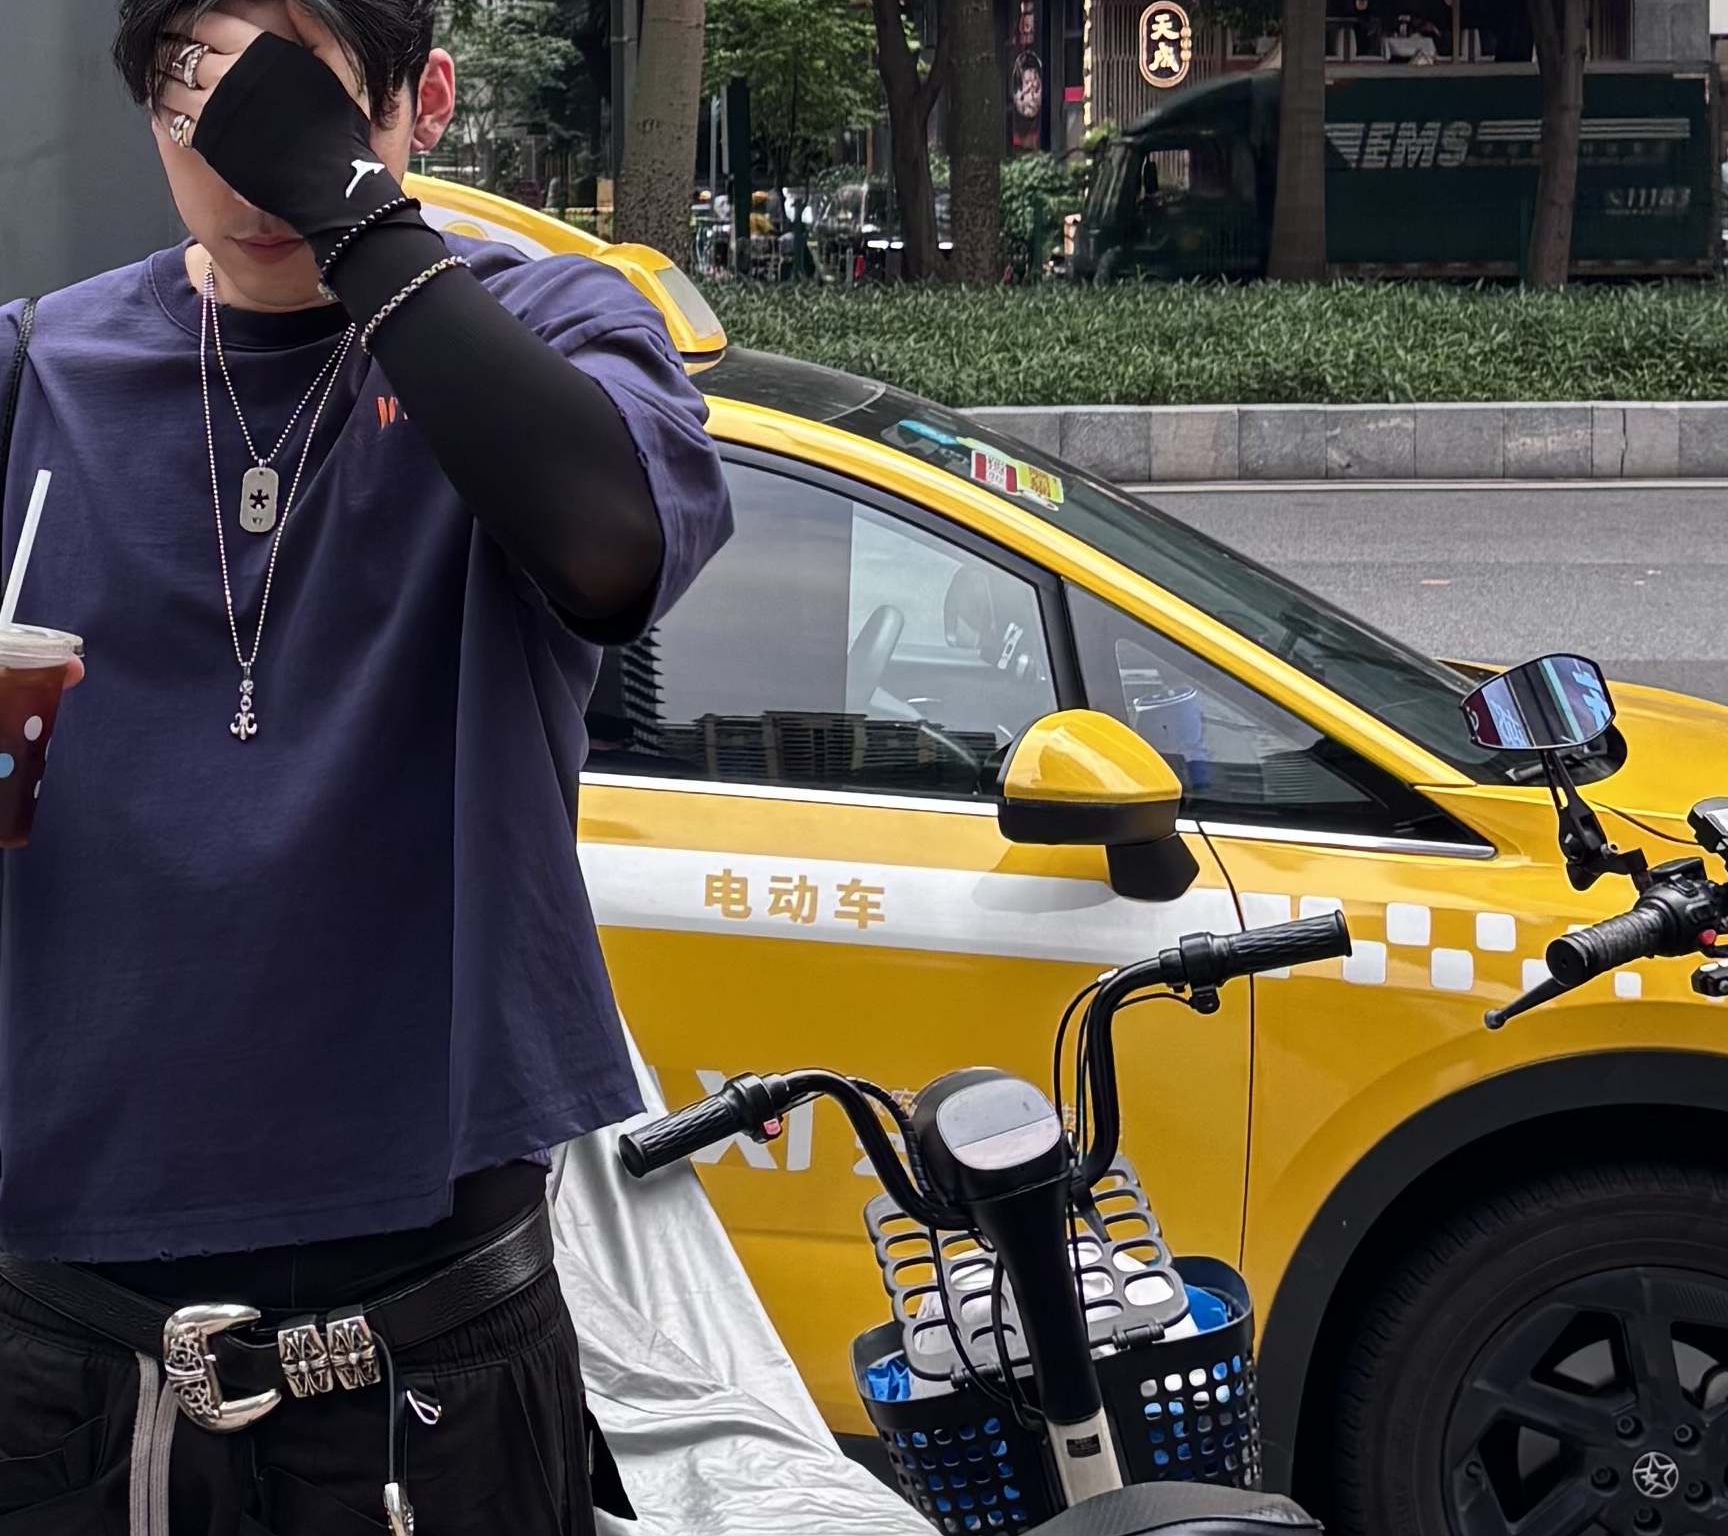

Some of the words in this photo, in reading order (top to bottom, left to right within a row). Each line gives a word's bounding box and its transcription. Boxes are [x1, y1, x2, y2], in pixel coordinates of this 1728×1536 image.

[1361, 121, 1472, 169] EMS
[703, 867, 887, 930] 电动车
